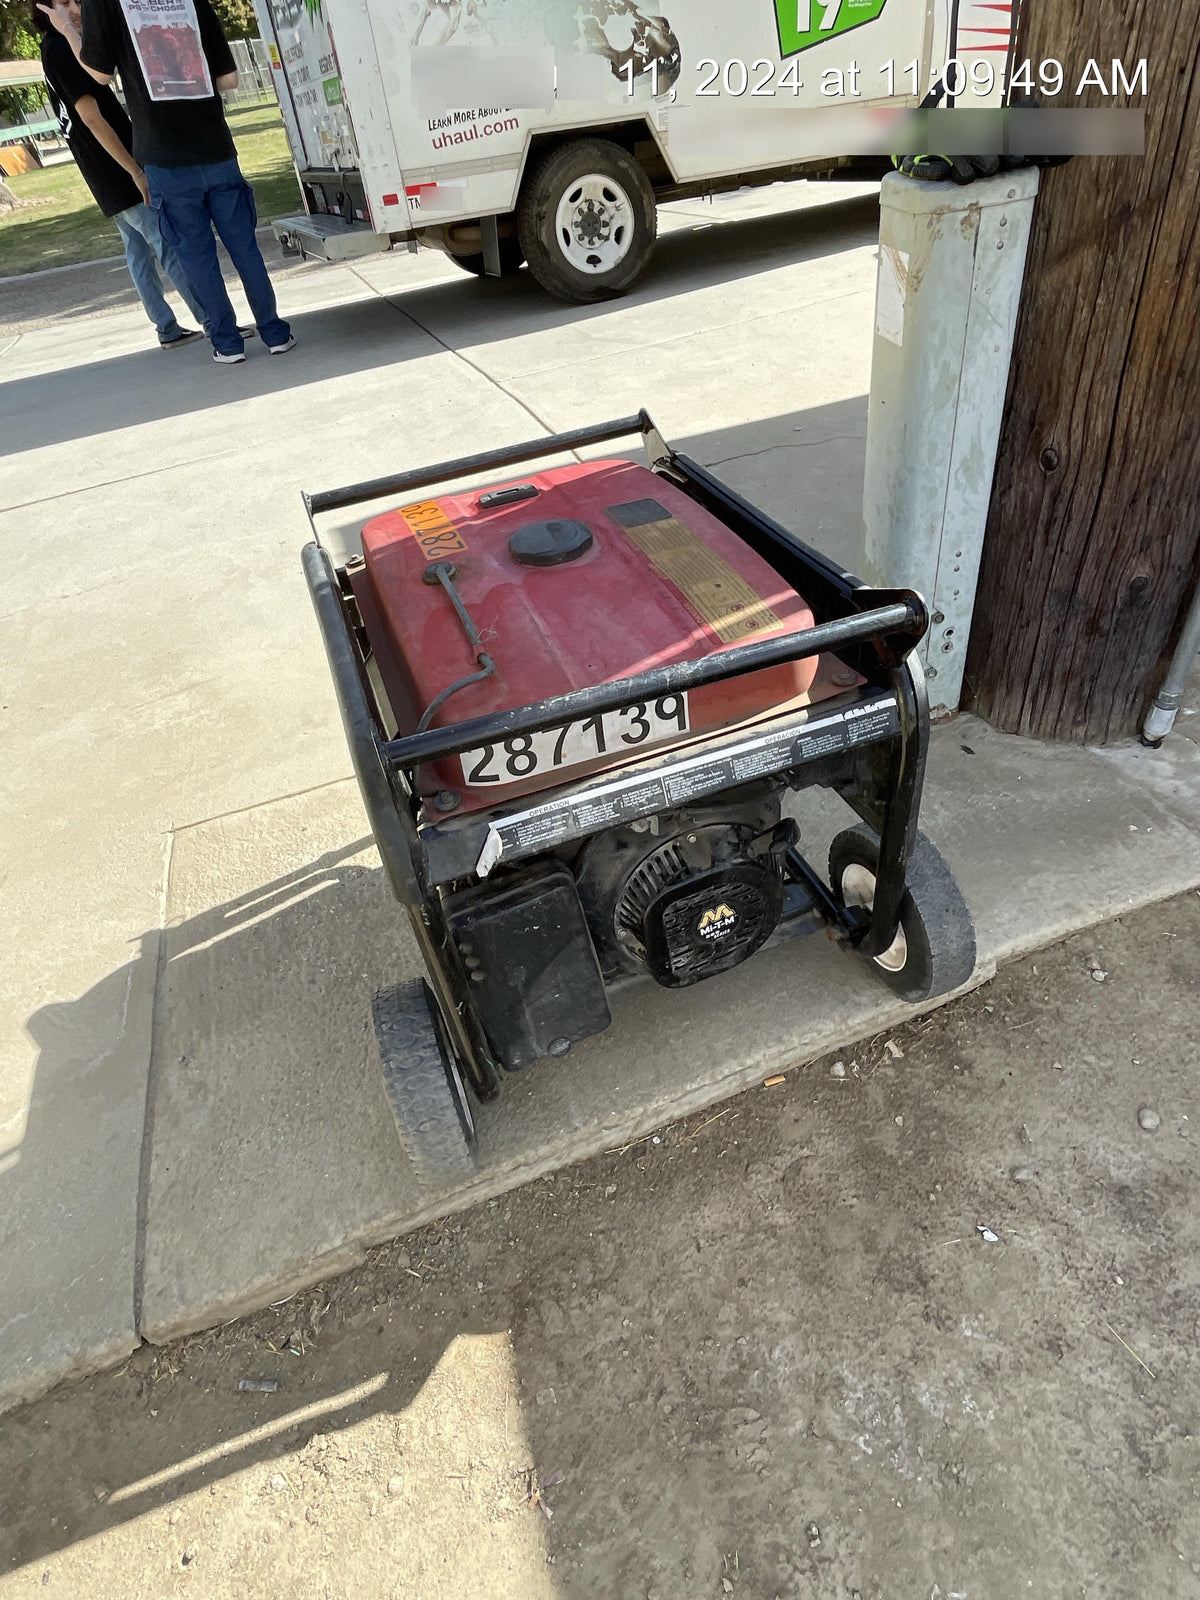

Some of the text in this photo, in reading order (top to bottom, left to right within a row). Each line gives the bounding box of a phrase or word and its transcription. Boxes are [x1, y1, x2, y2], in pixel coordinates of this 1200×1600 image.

[428, 115, 452, 131] LEARN
[453, 109, 476, 125] MORE
[432, 117, 519, 150] uhaul.com
[468, 692, 687, 782] 287139
[528, 800, 570, 817] OPERATION
